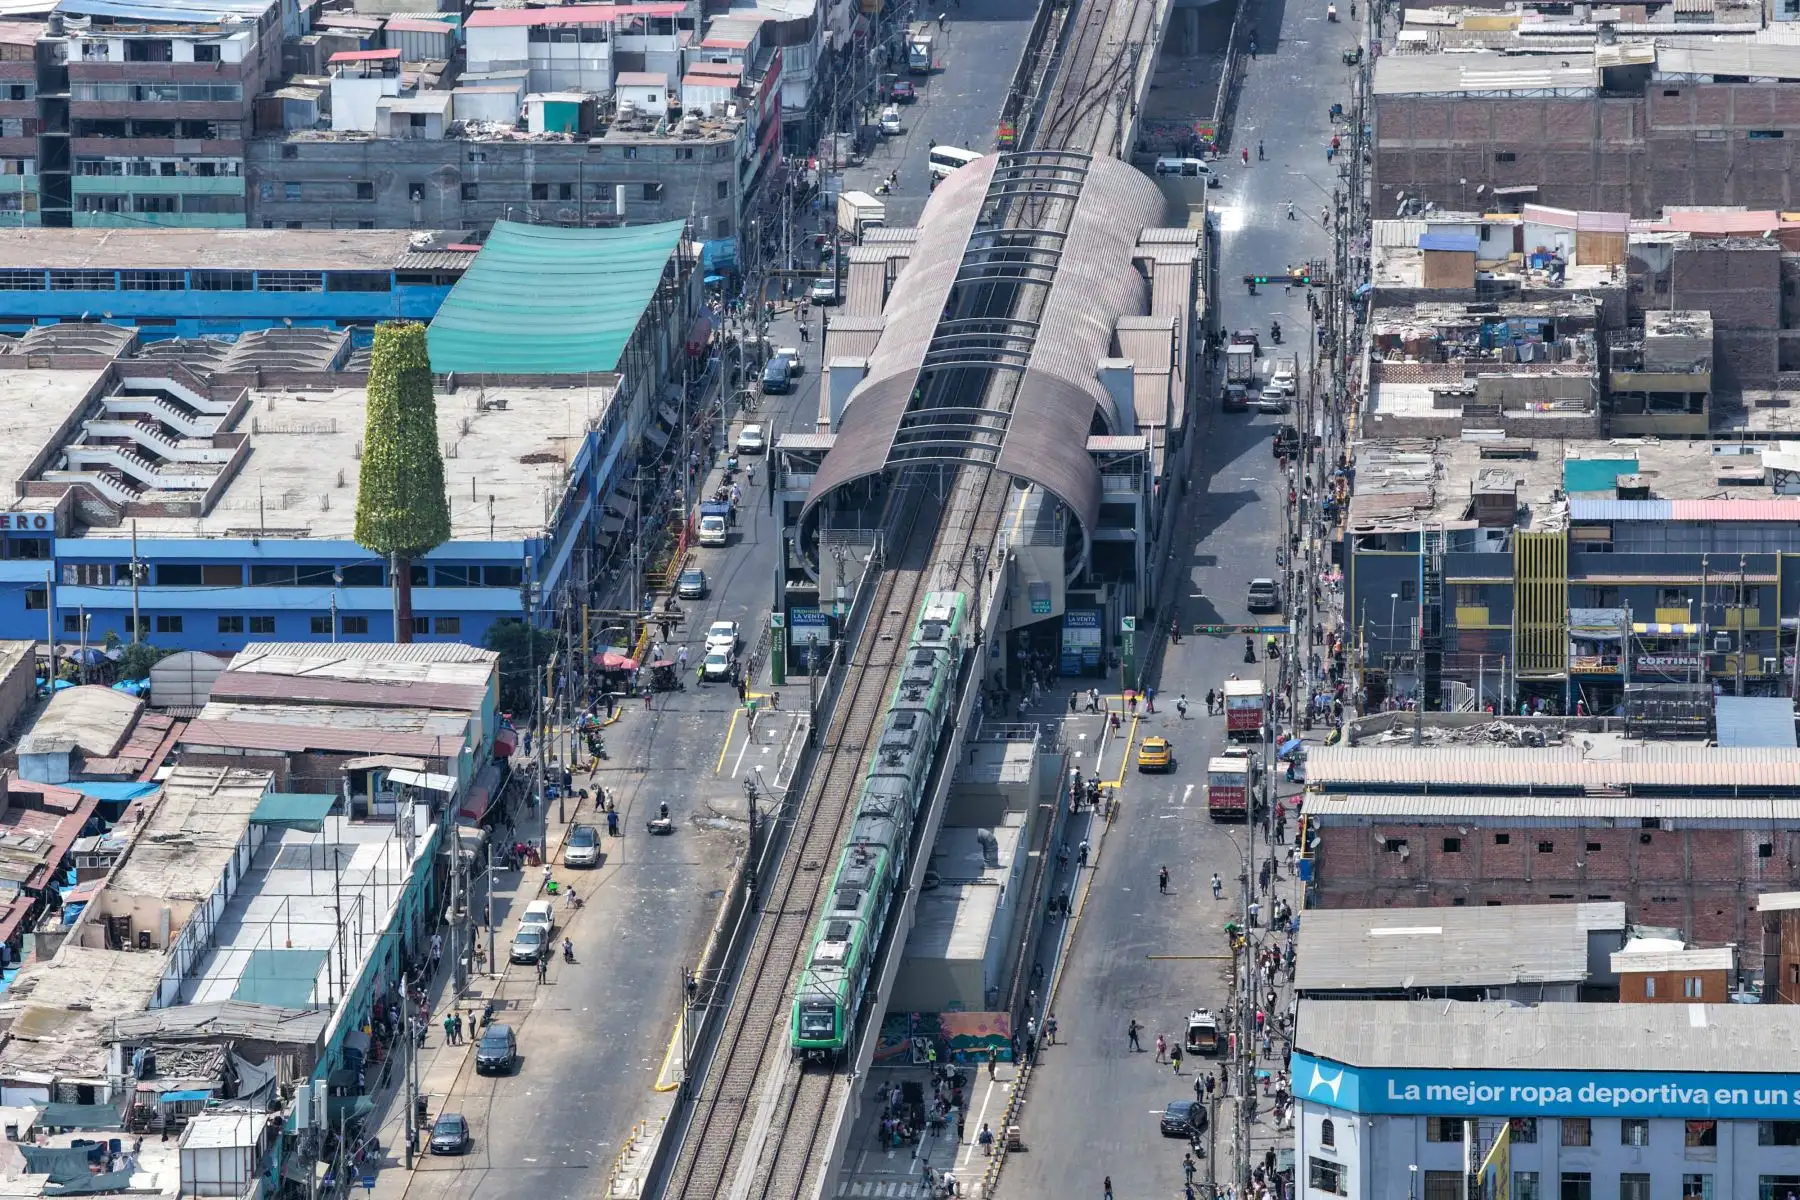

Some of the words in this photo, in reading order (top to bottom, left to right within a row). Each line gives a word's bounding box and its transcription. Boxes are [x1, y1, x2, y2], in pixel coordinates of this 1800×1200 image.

[0, 514, 47, 529] ERO
[1637, 657, 1698, 665] CORTINA
[1388, 1080, 1420, 1100] La
[1427, 1081, 1504, 1105] mejor
[1510, 1086, 1571, 1106] ropa
[1578, 1082, 1708, 1107] deportiva
[1715, 1089, 1748, 1104] en
[1754, 1090, 1788, 1105] un
